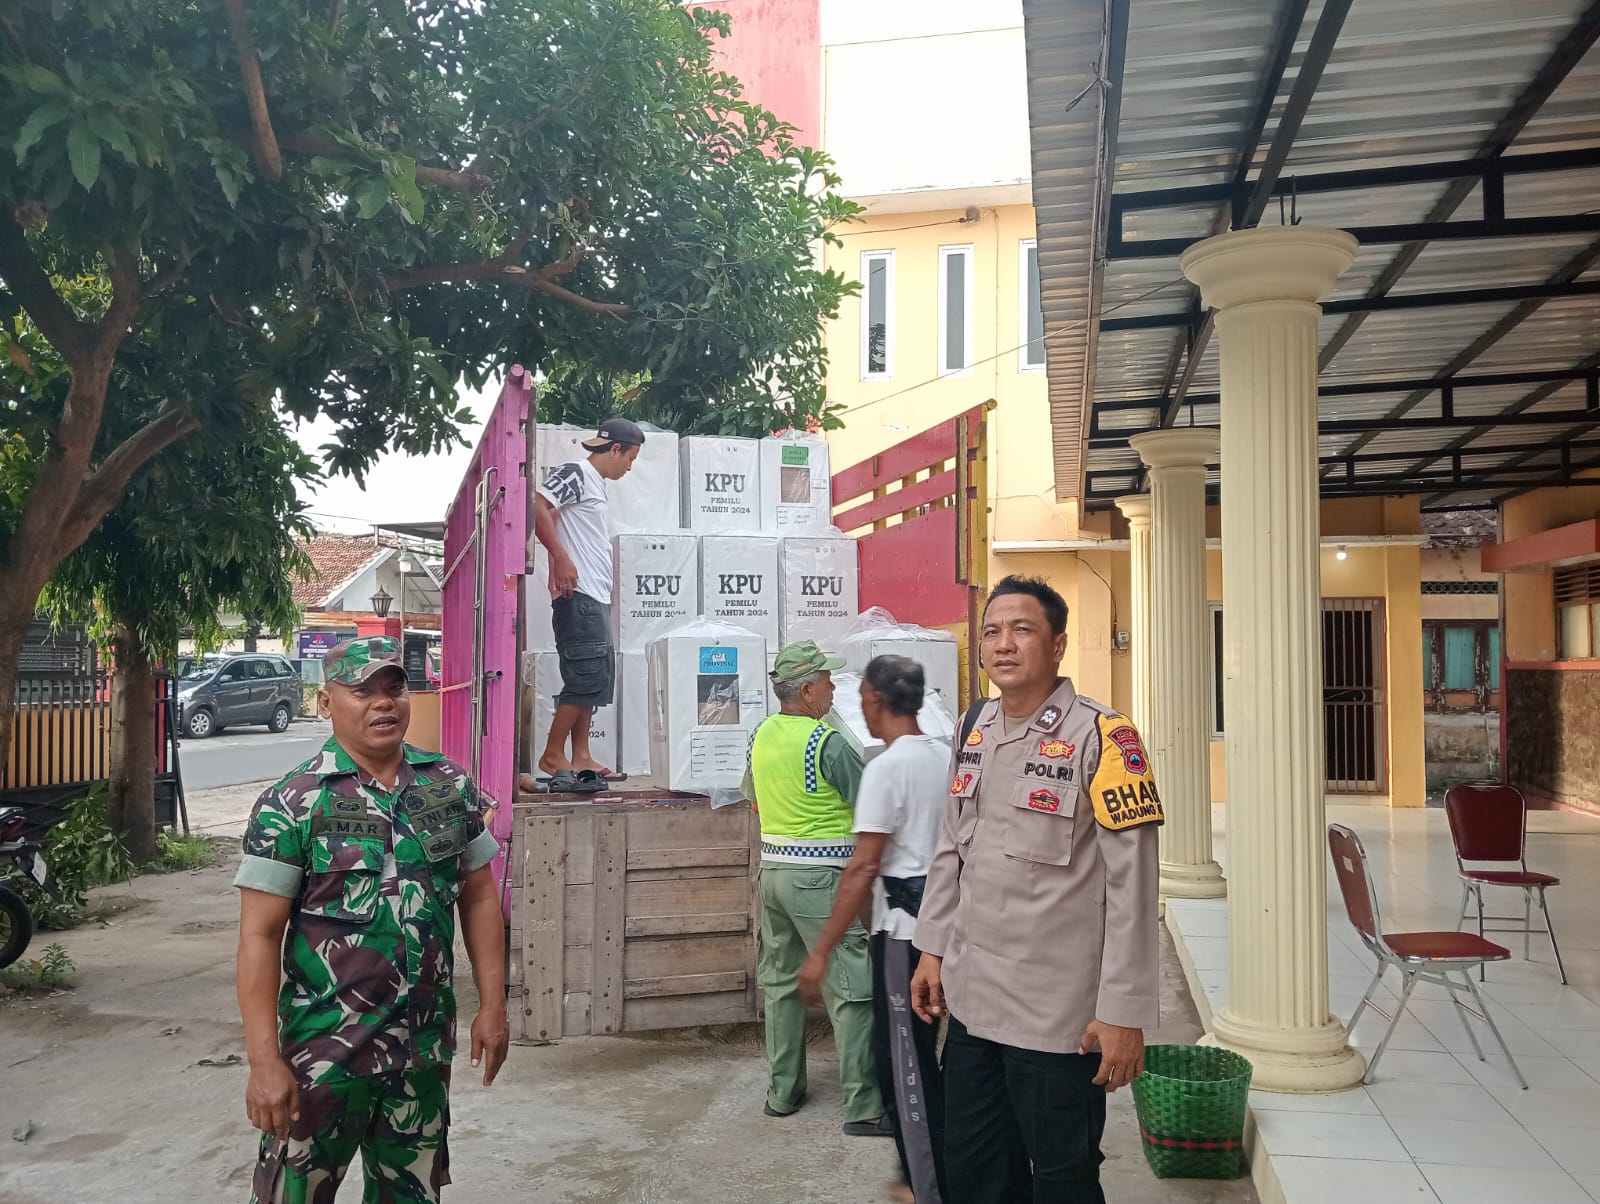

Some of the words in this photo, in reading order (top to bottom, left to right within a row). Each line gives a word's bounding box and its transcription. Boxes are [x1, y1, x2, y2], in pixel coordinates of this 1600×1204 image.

[705, 473, 745, 493] KPU
[701, 505, 729, 513] TAHUN
[731, 506, 751, 514] 2024
[635, 575, 681, 596] KPU
[718, 574, 763, 594] KPU
[801, 576, 844, 596] KPU
[642, 600, 676, 608] PEMILU
[631, 610, 662, 618] TAHUN
[588, 730, 606, 738] 024
[1024, 762, 1074, 782] POLRI
[417, 810, 442, 826] TNI
[323, 821, 378, 834] AMAR
